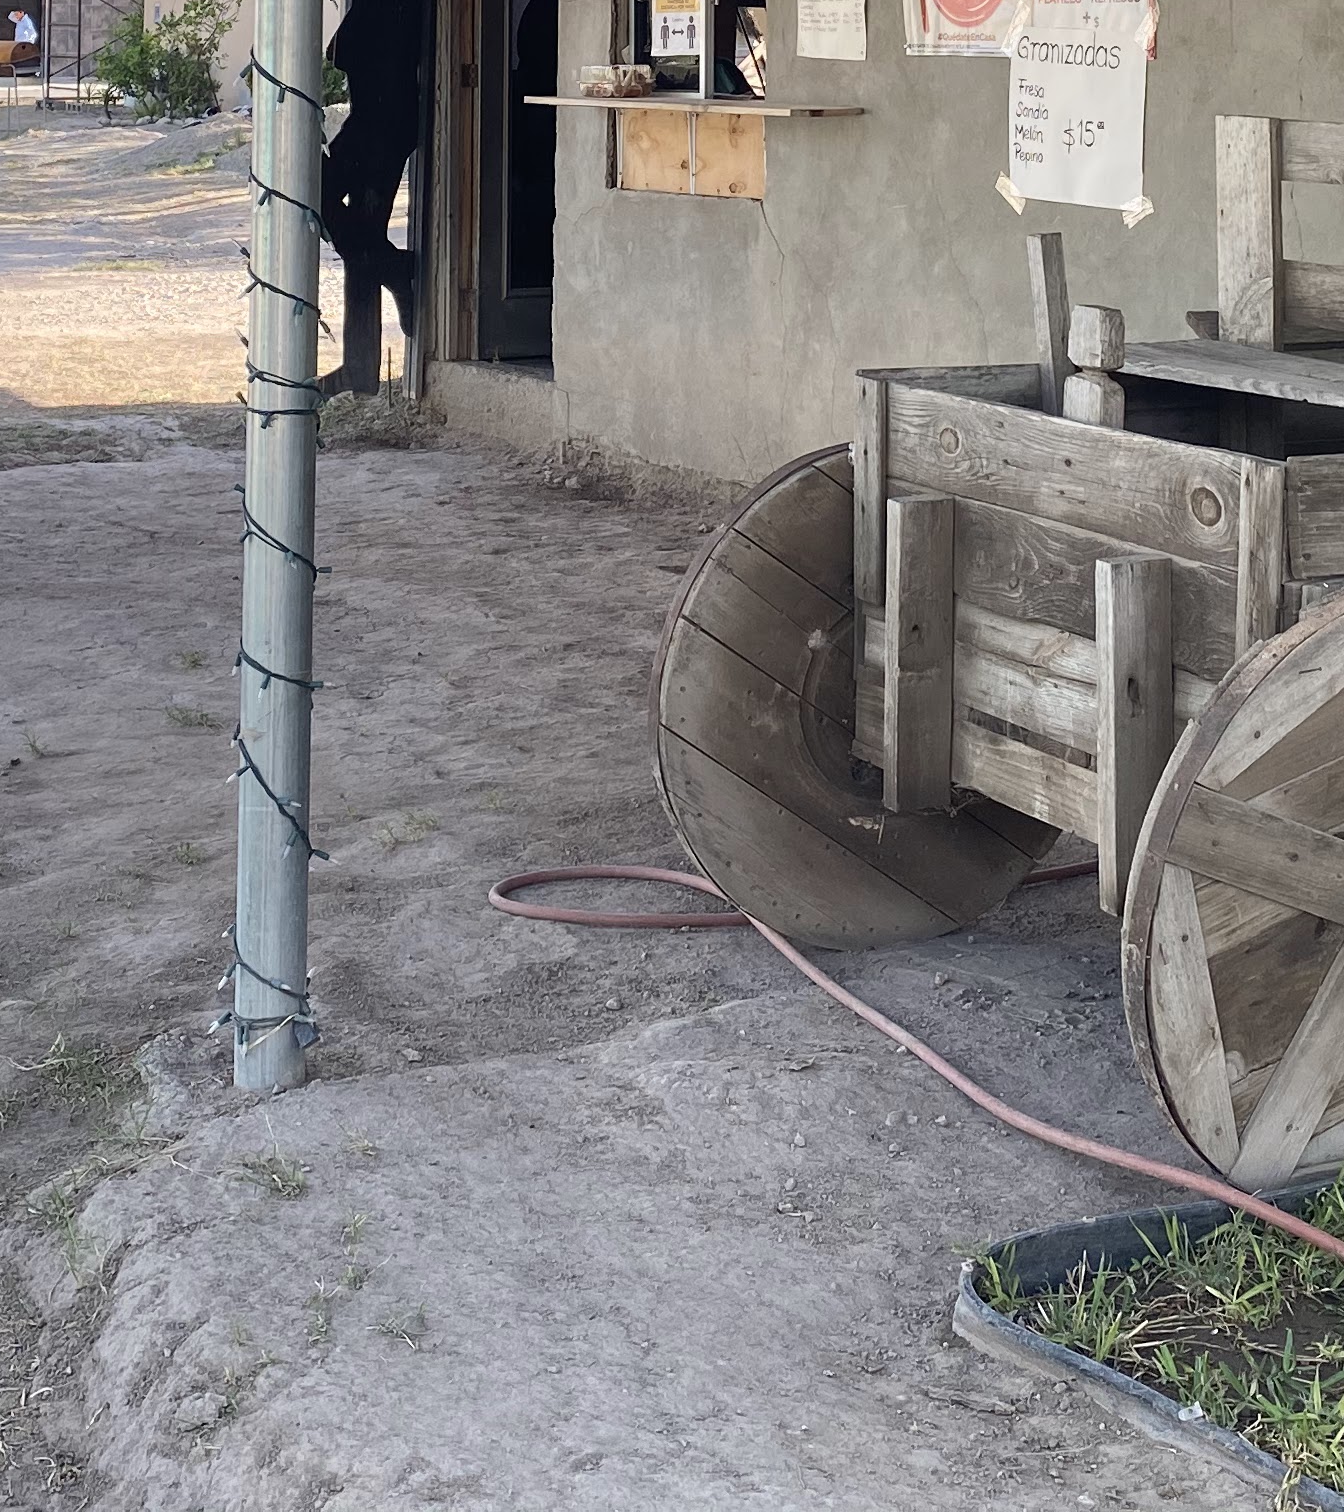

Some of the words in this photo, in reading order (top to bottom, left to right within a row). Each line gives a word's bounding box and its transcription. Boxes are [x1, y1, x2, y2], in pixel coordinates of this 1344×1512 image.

[1017, 31, 1122, 69] Granizadas
[1018, 78, 1045, 98] Fresa
[1015, 124, 1044, 143] Melón
[1013, 142, 1044, 168] Pepino
